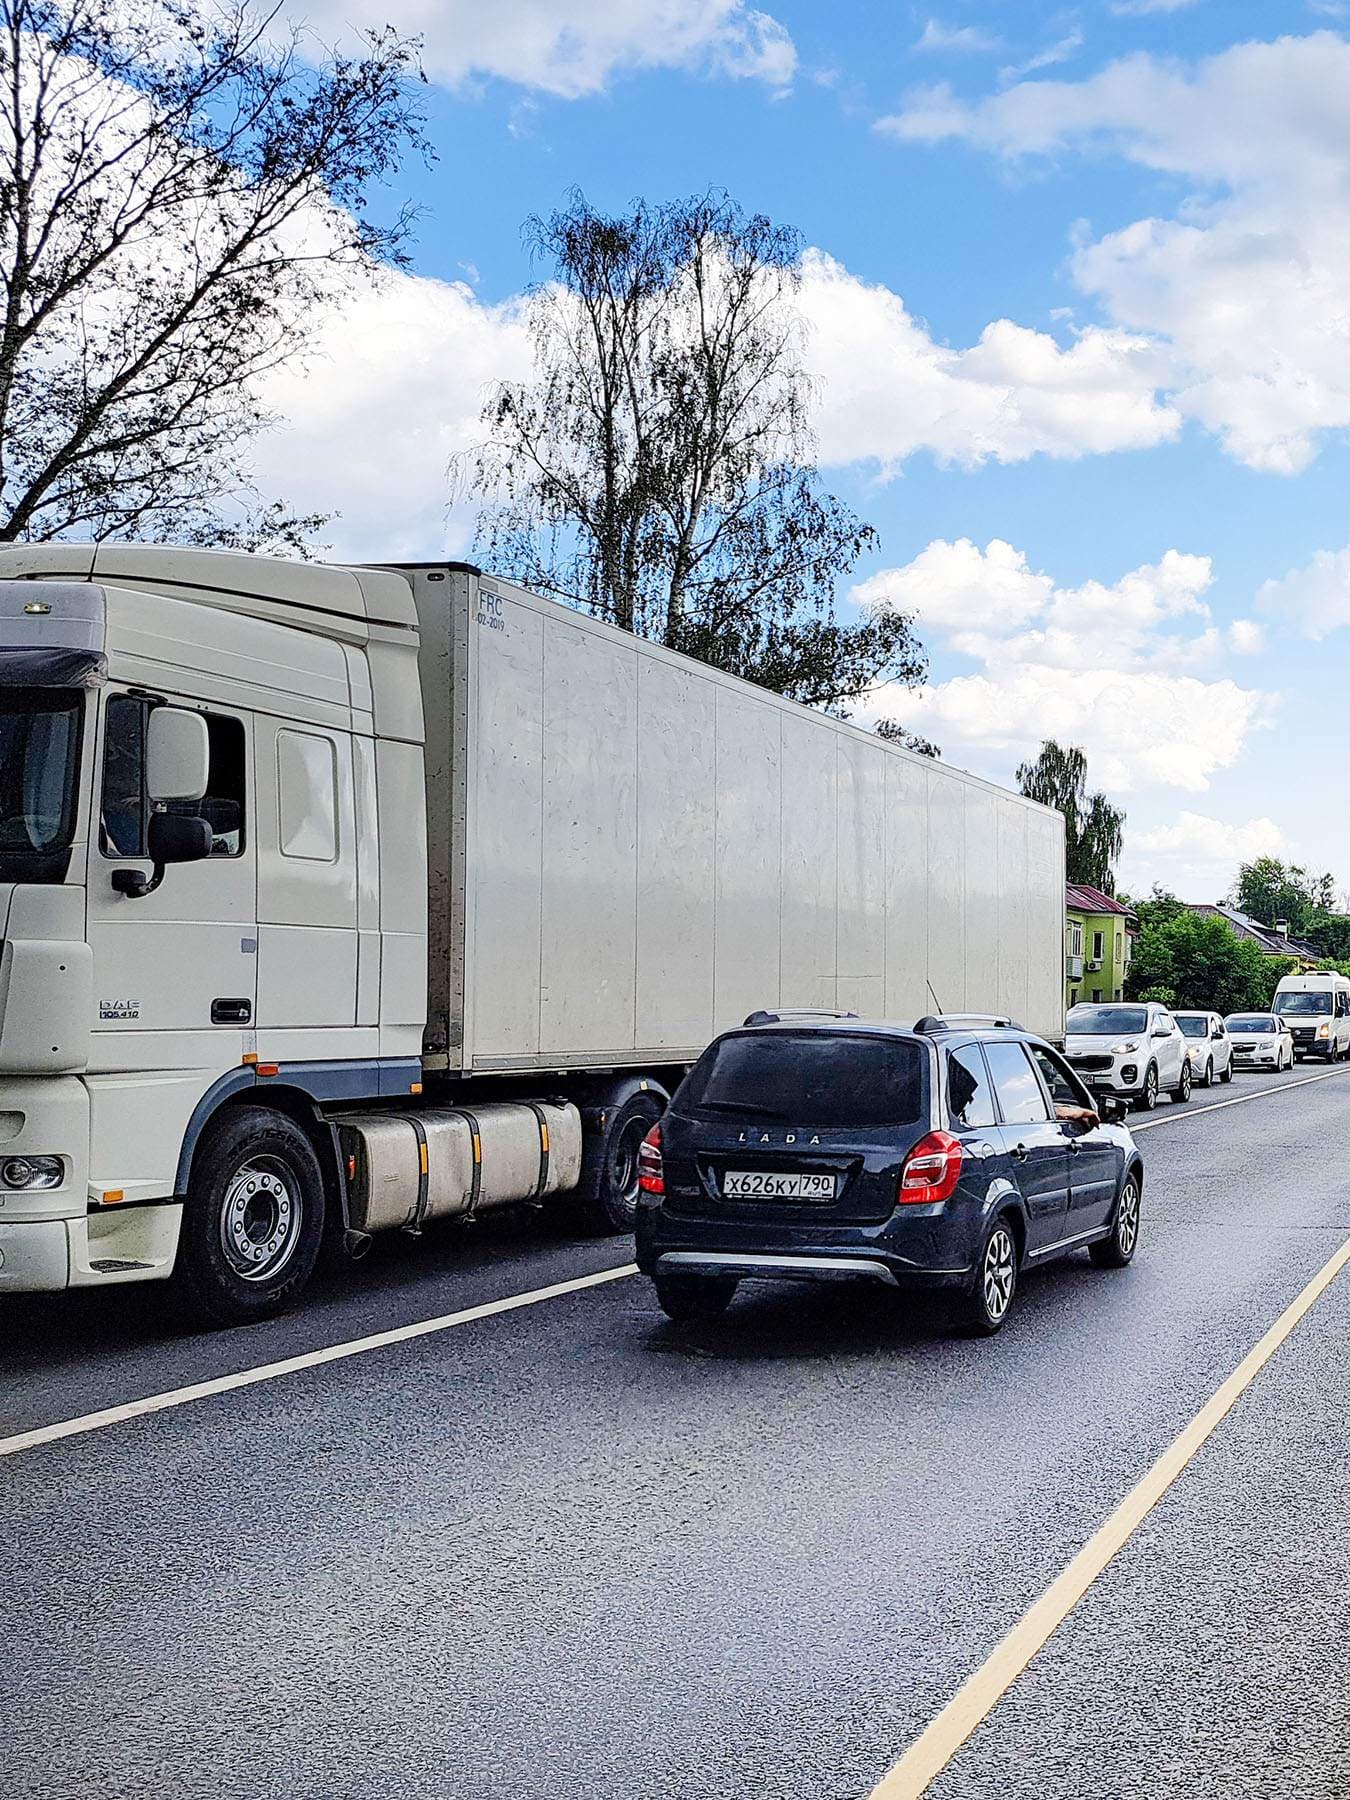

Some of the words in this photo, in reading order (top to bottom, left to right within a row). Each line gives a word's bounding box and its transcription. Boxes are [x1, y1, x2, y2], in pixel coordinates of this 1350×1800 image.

[480, 591, 503, 616] FRC
[100, 999, 140, 1010] DAF
[738, 1133, 820, 1145] LADA
[803, 1176, 831, 1190] 790
